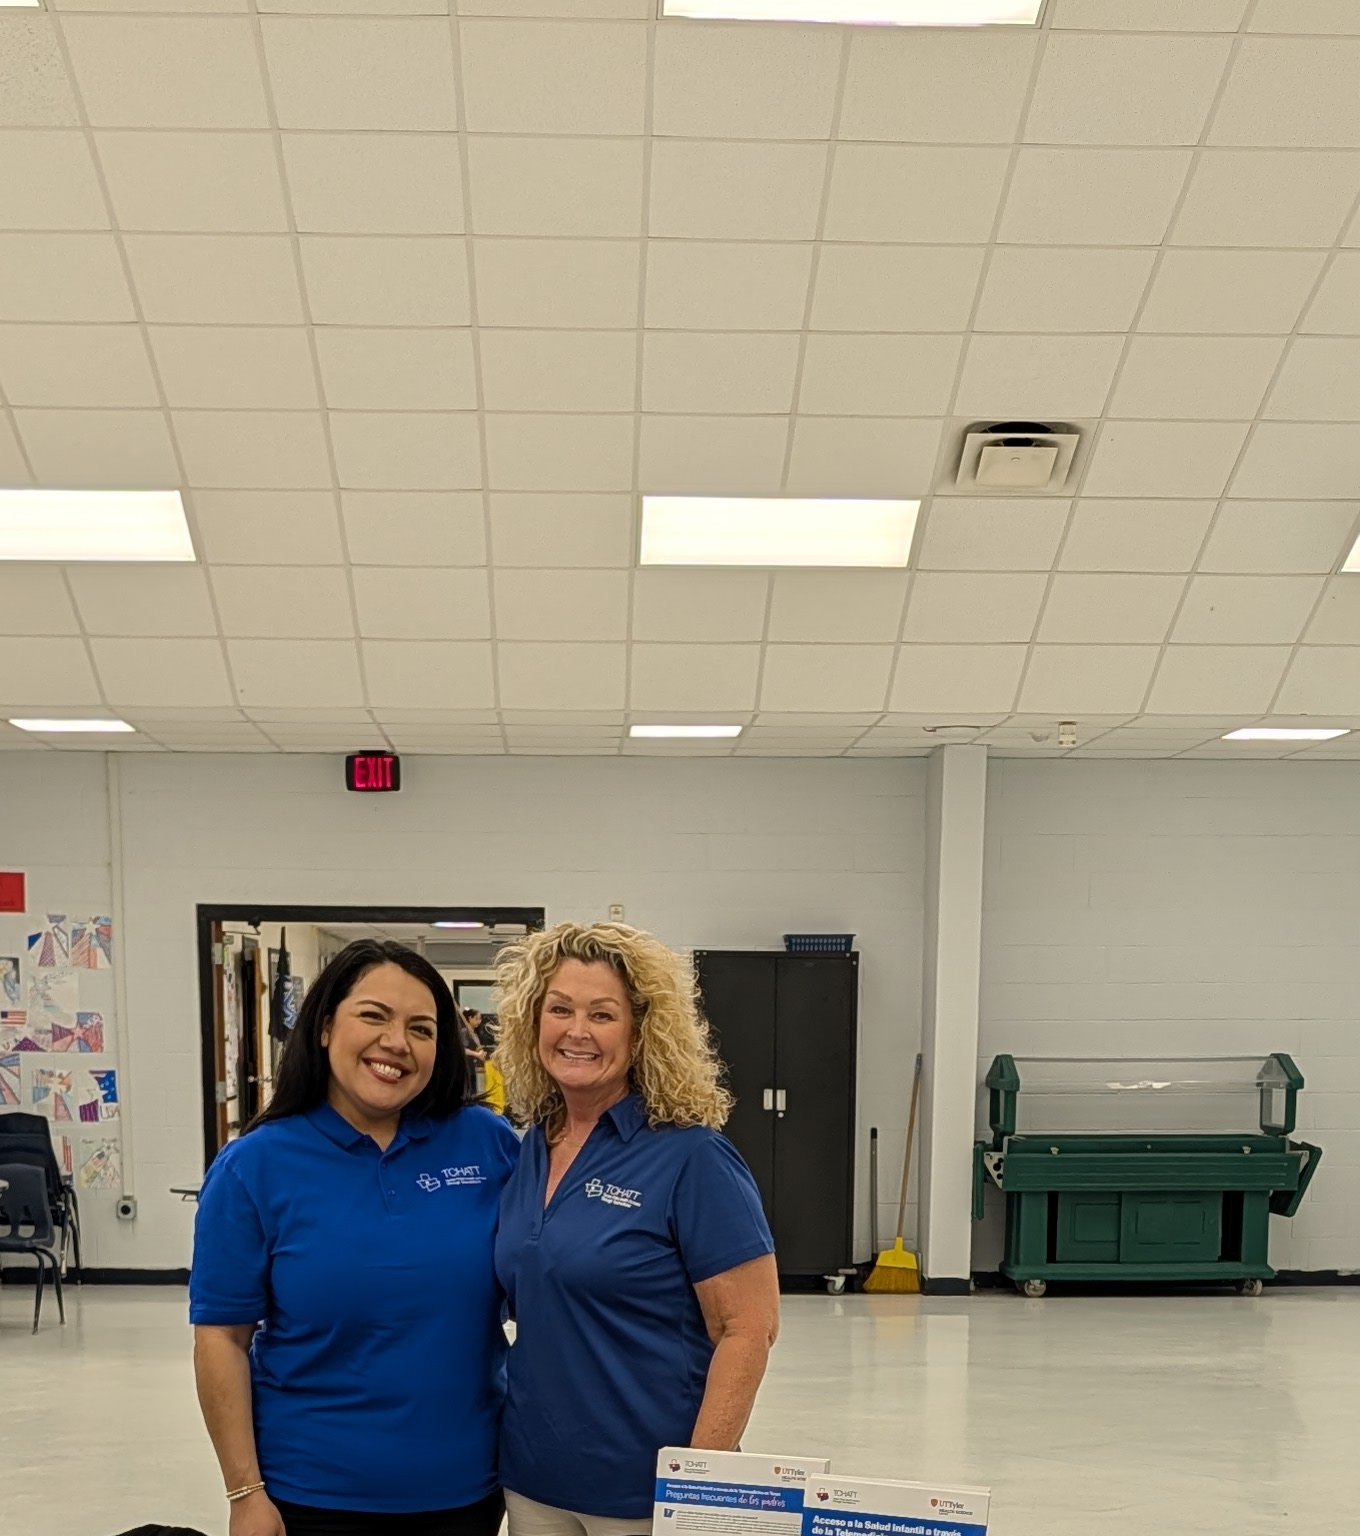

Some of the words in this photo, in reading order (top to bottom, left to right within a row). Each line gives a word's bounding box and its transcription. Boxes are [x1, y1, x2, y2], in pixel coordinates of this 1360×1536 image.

[355, 757, 393, 787] EXIT
[665, 1490, 700, 1501] Preguntas
[701, 1492, 737, 1503] frecuentes
[761, 1497, 786, 1509] padres
[813, 1515, 846, 1527] Acceso
[865, 1520, 891, 1531] Salud
[892, 1523, 925, 1535] Infantil
